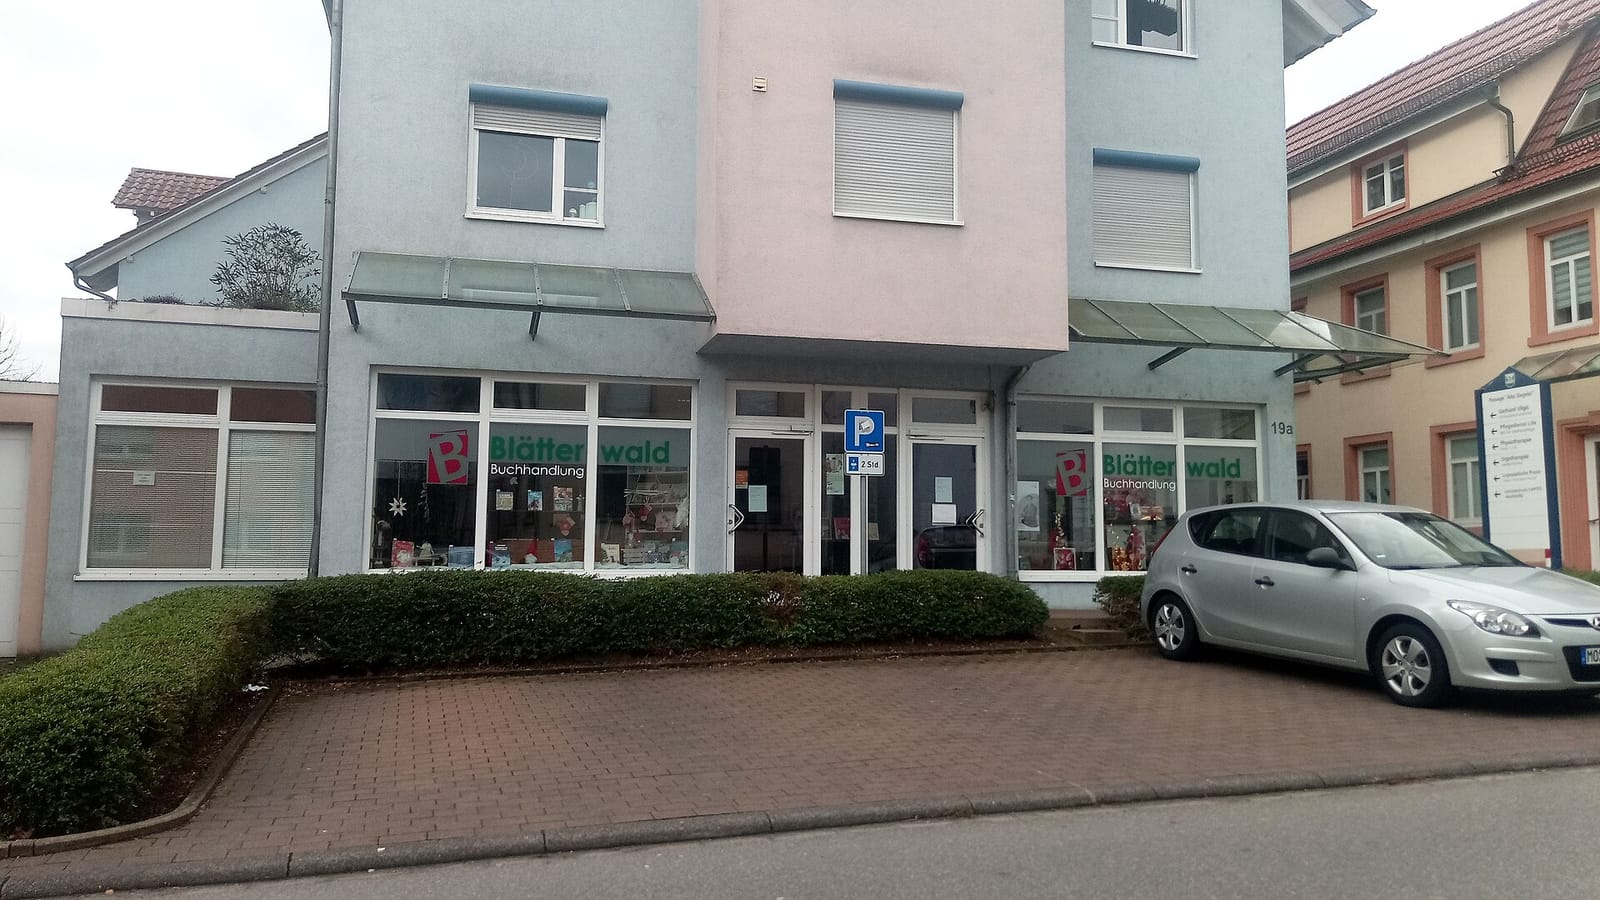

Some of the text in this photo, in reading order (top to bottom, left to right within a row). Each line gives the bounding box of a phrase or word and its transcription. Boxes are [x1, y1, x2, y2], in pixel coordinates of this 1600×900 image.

[854, 415, 875, 447] P
[1271, 421, 1294, 435] 19a
[427, 430, 468, 484] B
[490, 435, 670, 464] Blätter wald
[490, 463, 584, 479] Buchhandlung
[861, 460, 879, 468] 2 Std
[1056, 449, 1087, 496] B
[1103, 454, 1241, 478] Blätter wald
[1103, 477, 1176, 492] Buchhandlung
[1586, 649, 1600, 663] MO
